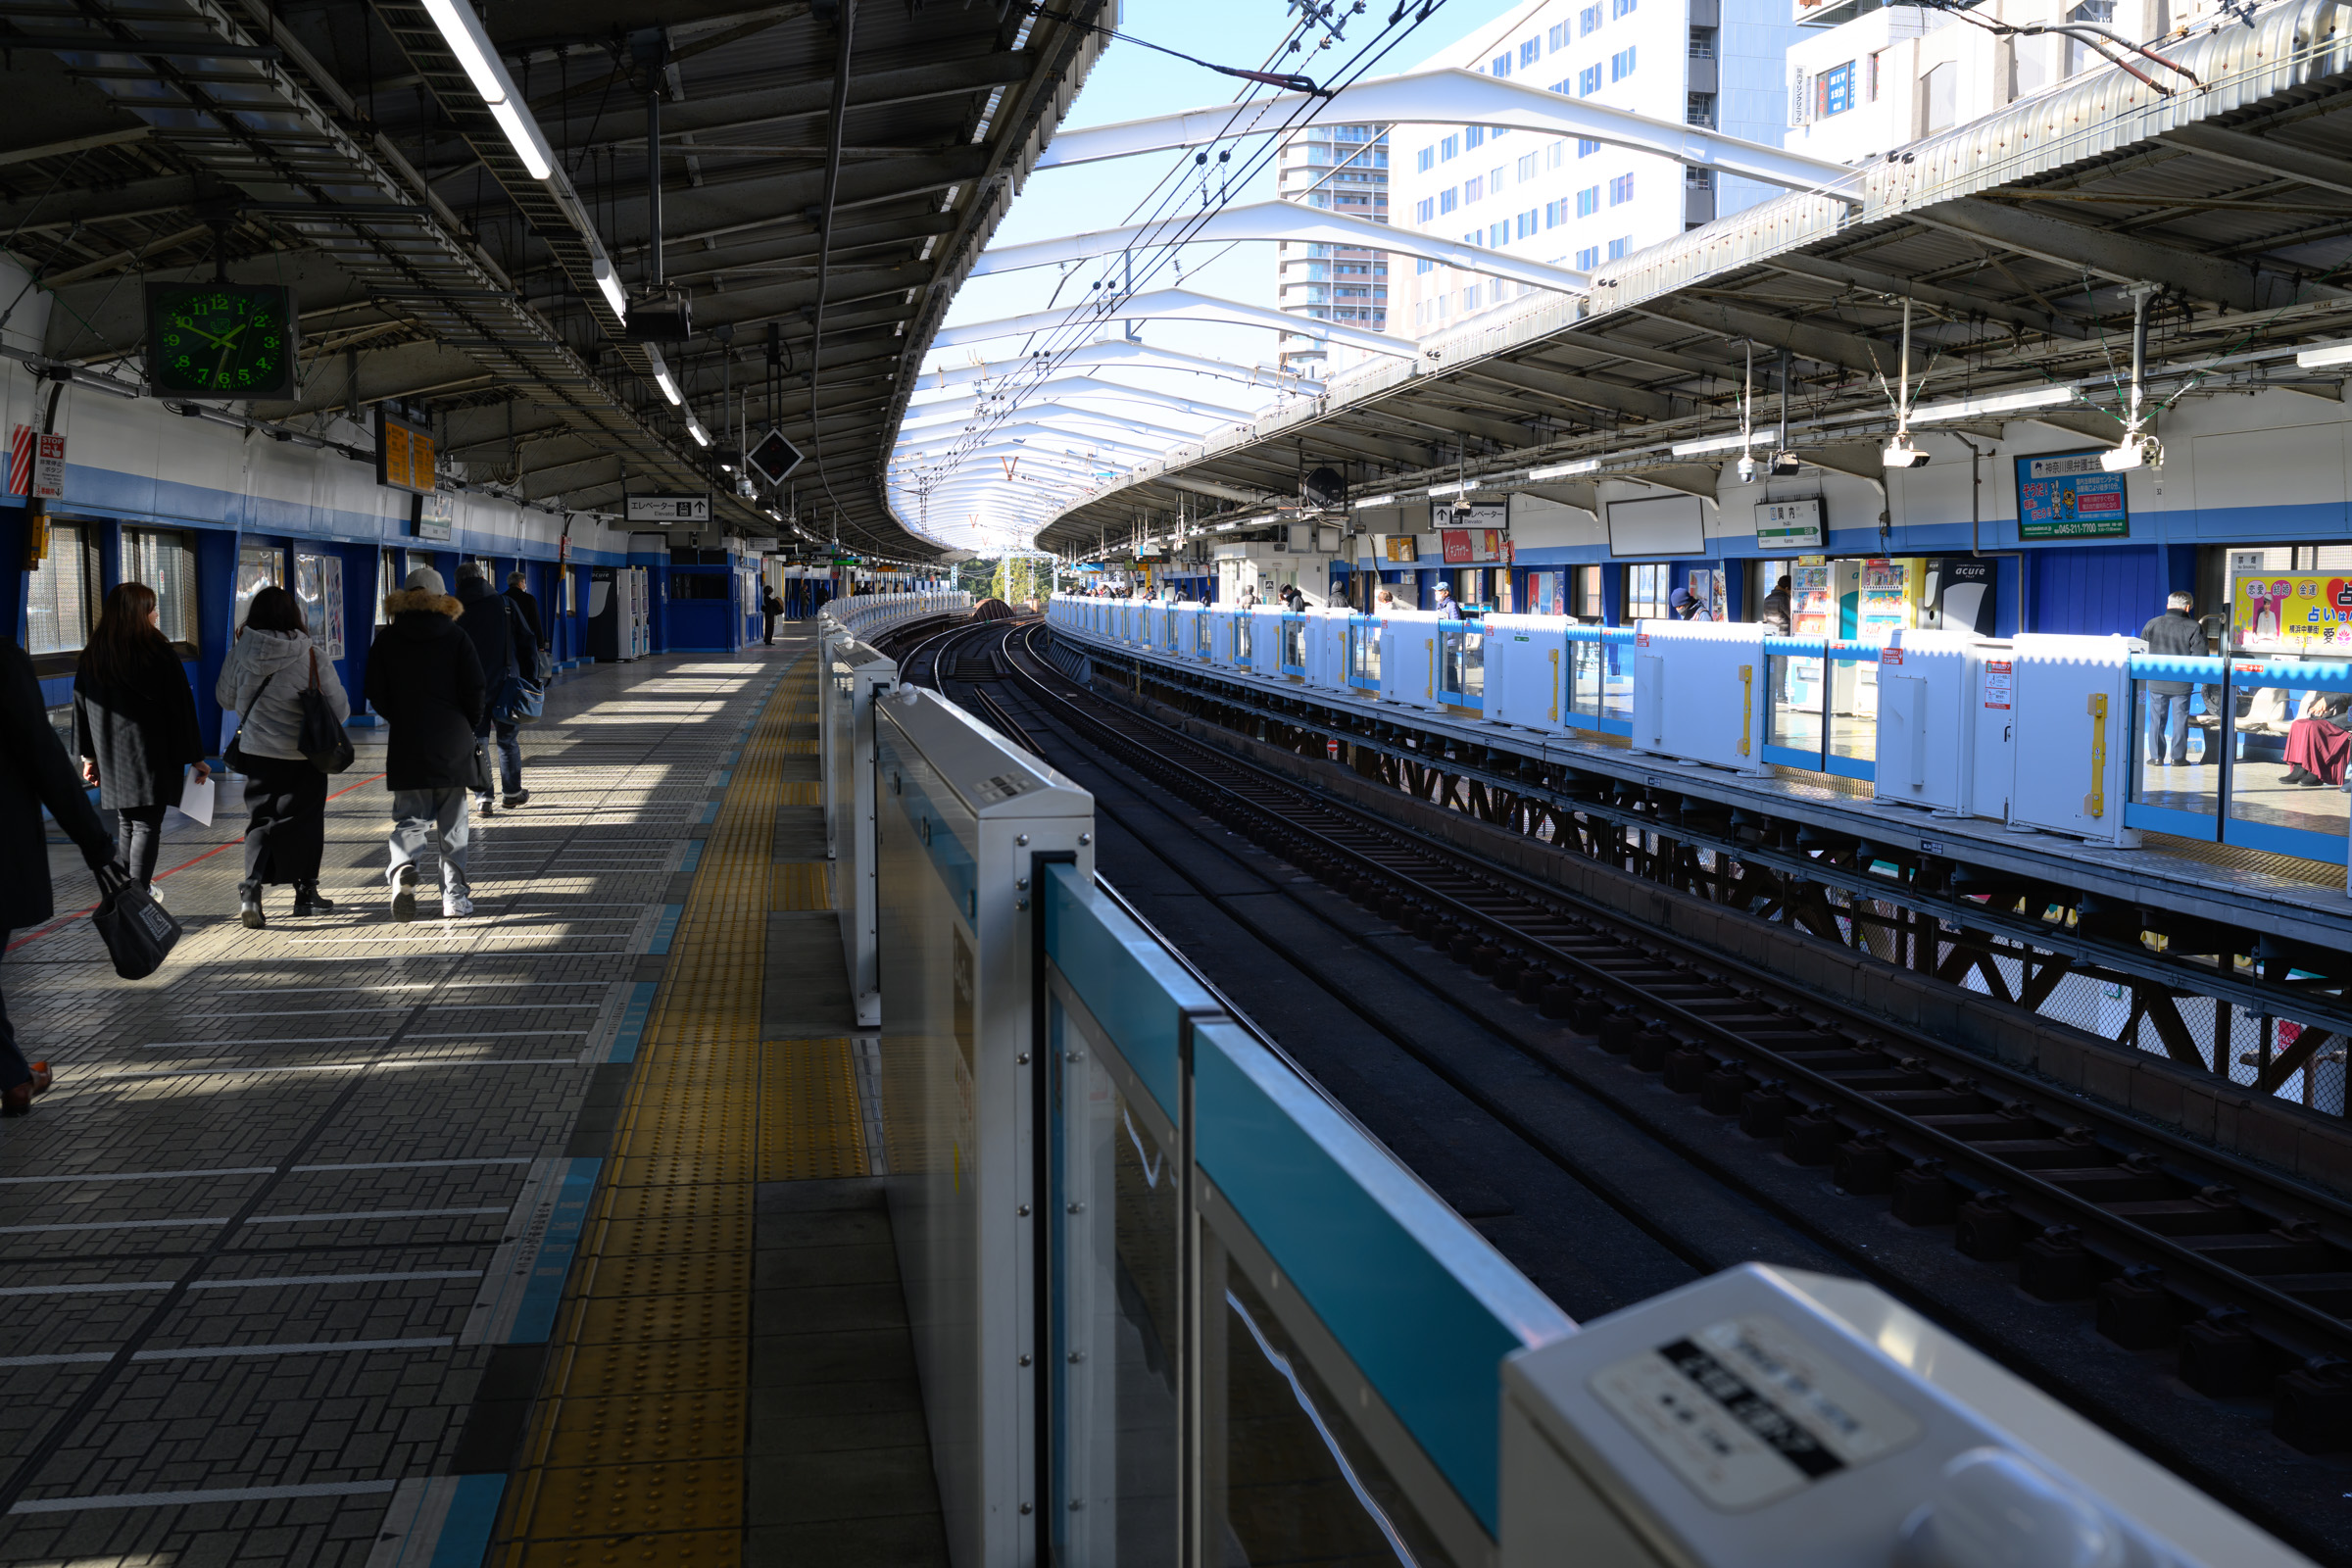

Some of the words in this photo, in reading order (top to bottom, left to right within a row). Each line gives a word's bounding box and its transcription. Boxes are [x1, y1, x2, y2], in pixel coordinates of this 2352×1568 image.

[1831, 72, 1846, 86] HIV
[194, 303, 208, 315] 11
[210, 298, 228, 310] 12
[237, 303, 245, 315] 1
[175, 316, 193, 328] 10
[210, 318, 231, 334] JR
[254, 316, 266, 327] 2
[168, 335, 180, 346] 9
[264, 337, 275, 348] 3
[178, 355, 191, 367] 8
[255, 357, 268, 368] 4
[198, 368, 209, 380] 7
[218, 372, 230, 384] 6
[238, 368, 249, 381] 5
[2045, 458, 2103, 474] 神奈川県弁護士会
[1466, 510, 1504, 518] レベーター
[1778, 506, 1795, 520] 関内
[2059, 523, 2096, 534] 045-211-7700
[2238, 556, 2256, 564] 禁煙
[2248, 584, 2264, 595] 恋愛
[2273, 583, 2290, 596] 結婚
[2299, 584, 2317, 596] 金運
[2289, 624, 2319, 635] 横浜中華街
[2323, 627, 2335, 644] 愛
